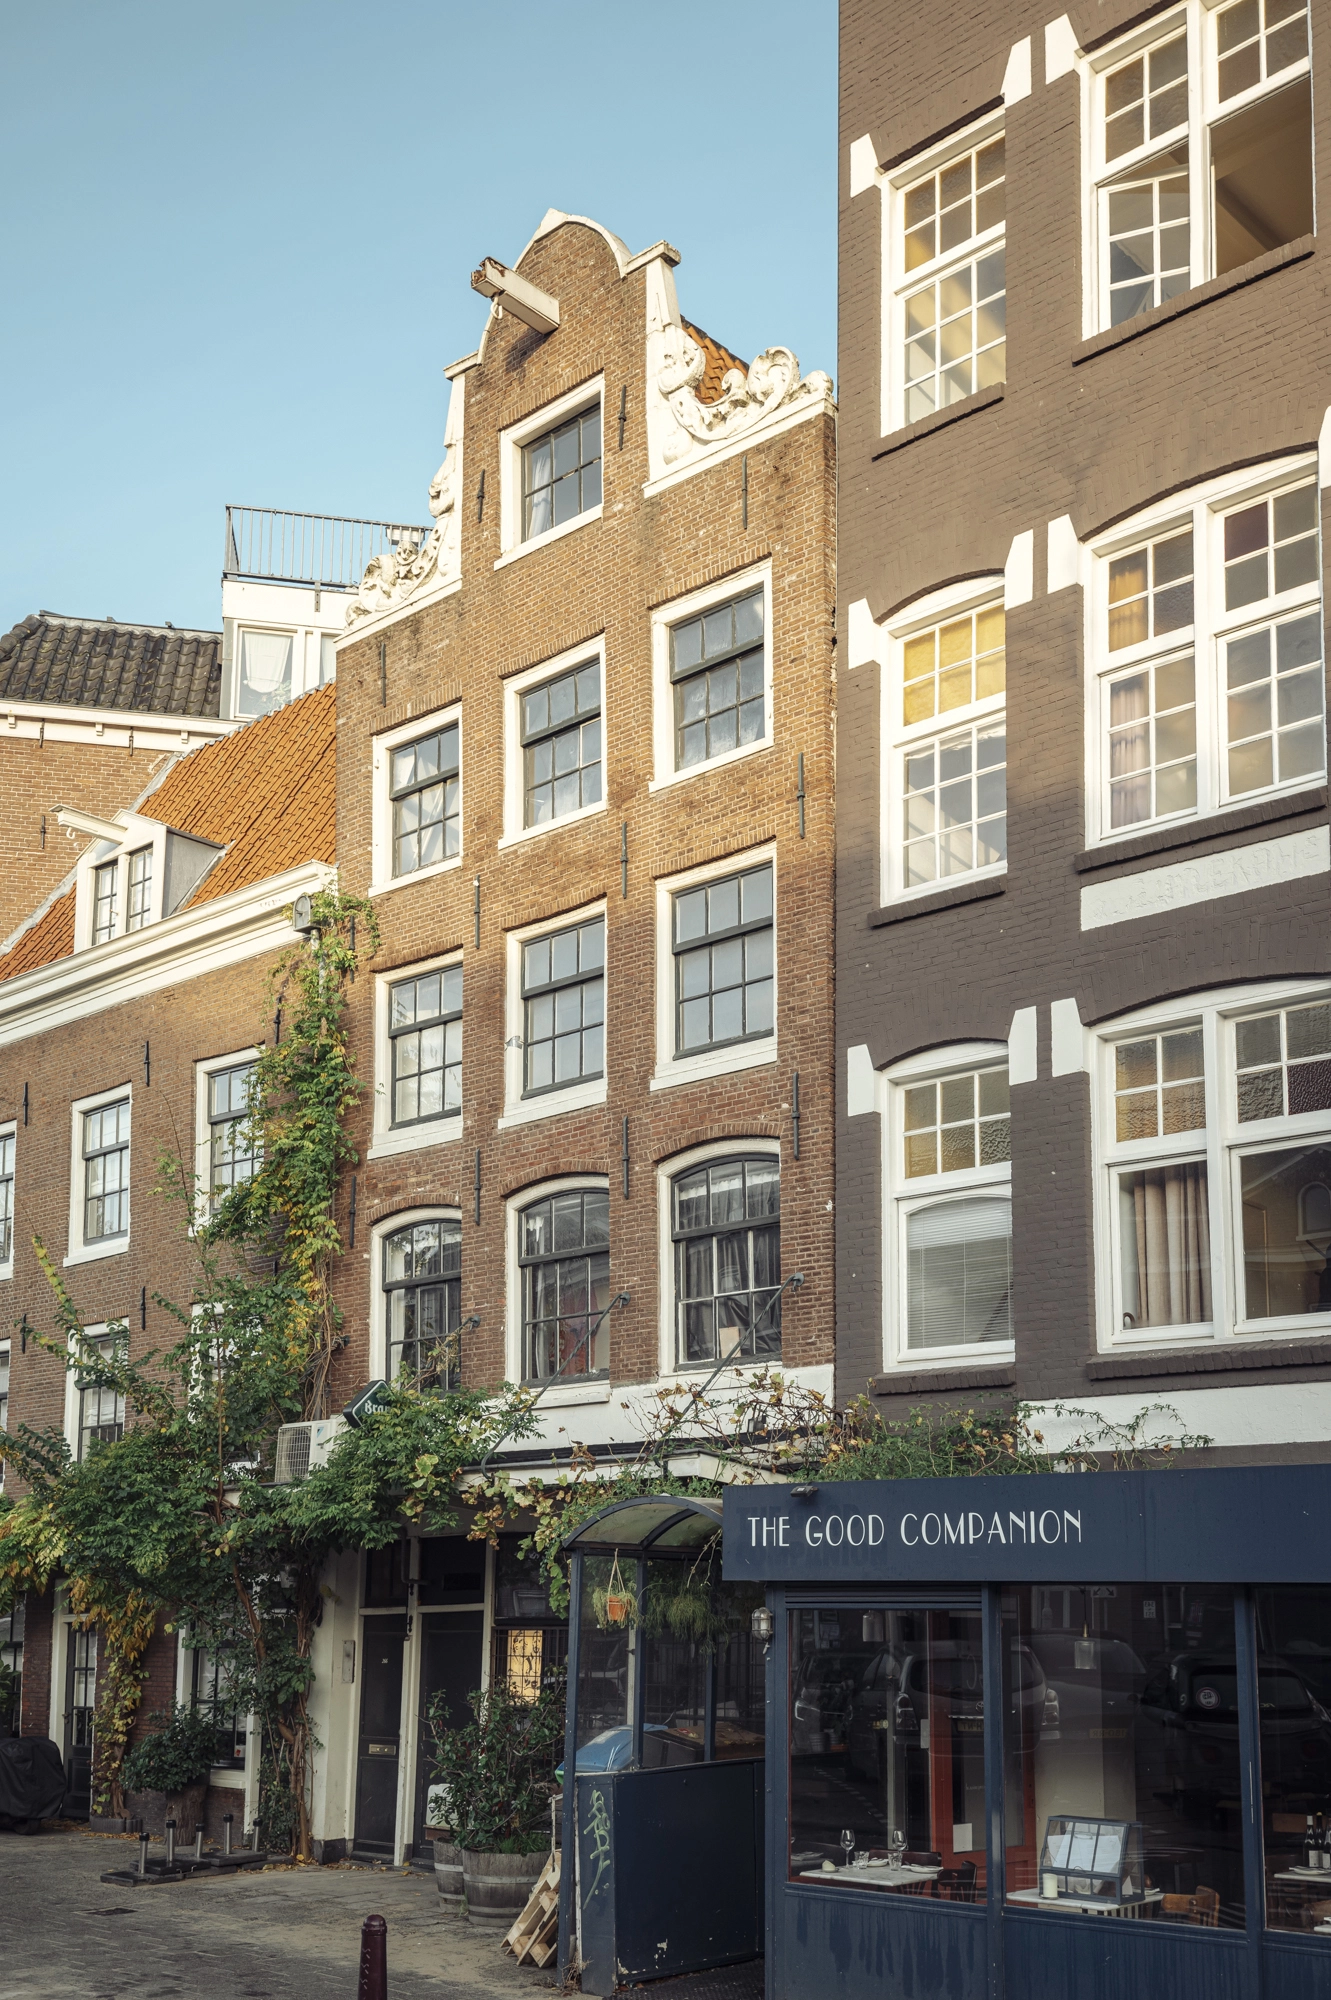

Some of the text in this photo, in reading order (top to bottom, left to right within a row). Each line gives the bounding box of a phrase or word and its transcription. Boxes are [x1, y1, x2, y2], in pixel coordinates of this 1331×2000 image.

[747, 1509, 1083, 1547] THE GOOD COMPANION
